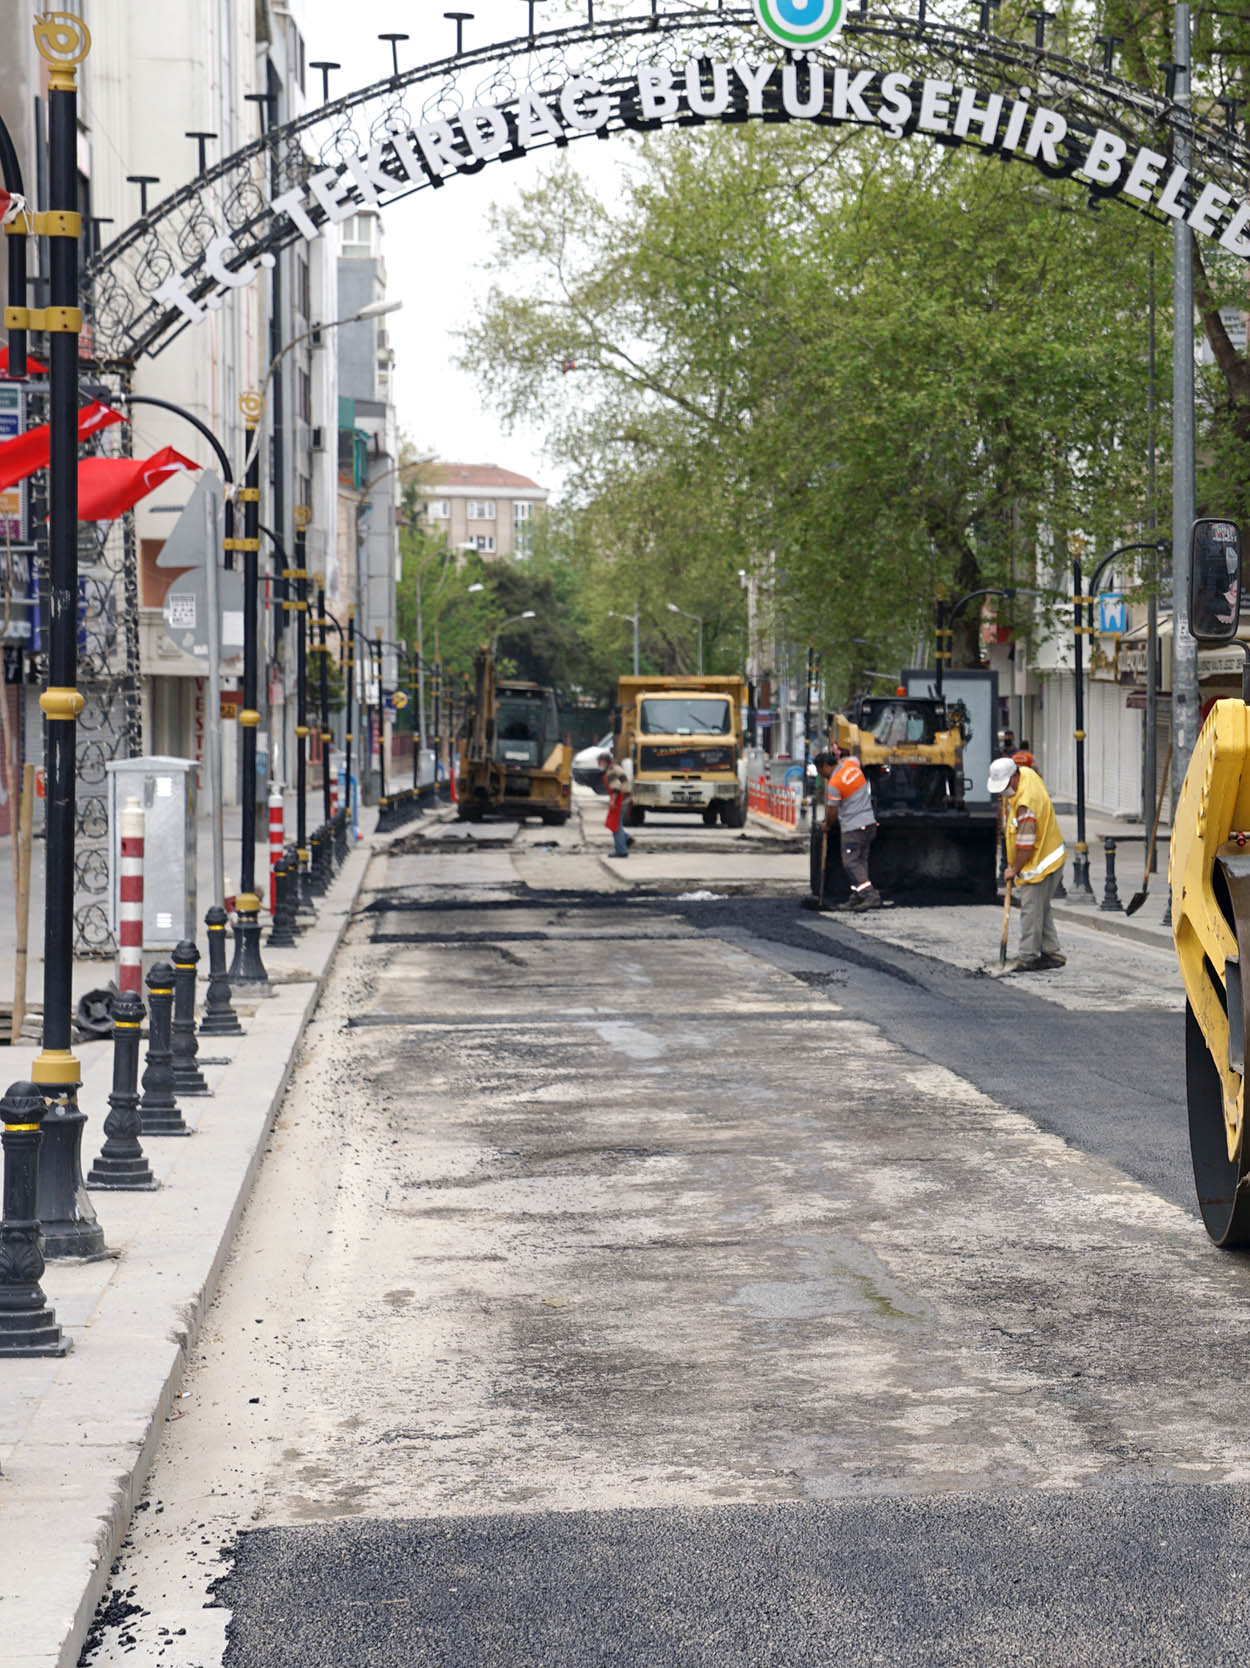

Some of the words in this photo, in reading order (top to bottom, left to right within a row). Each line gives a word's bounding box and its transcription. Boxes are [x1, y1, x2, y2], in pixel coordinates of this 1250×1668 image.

[153, 235, 276, 325] T.C.
[270, 65, 611, 241] TEKİRDAĞ
[637, 51, 1068, 166] BÜYÜKŞEHİR
